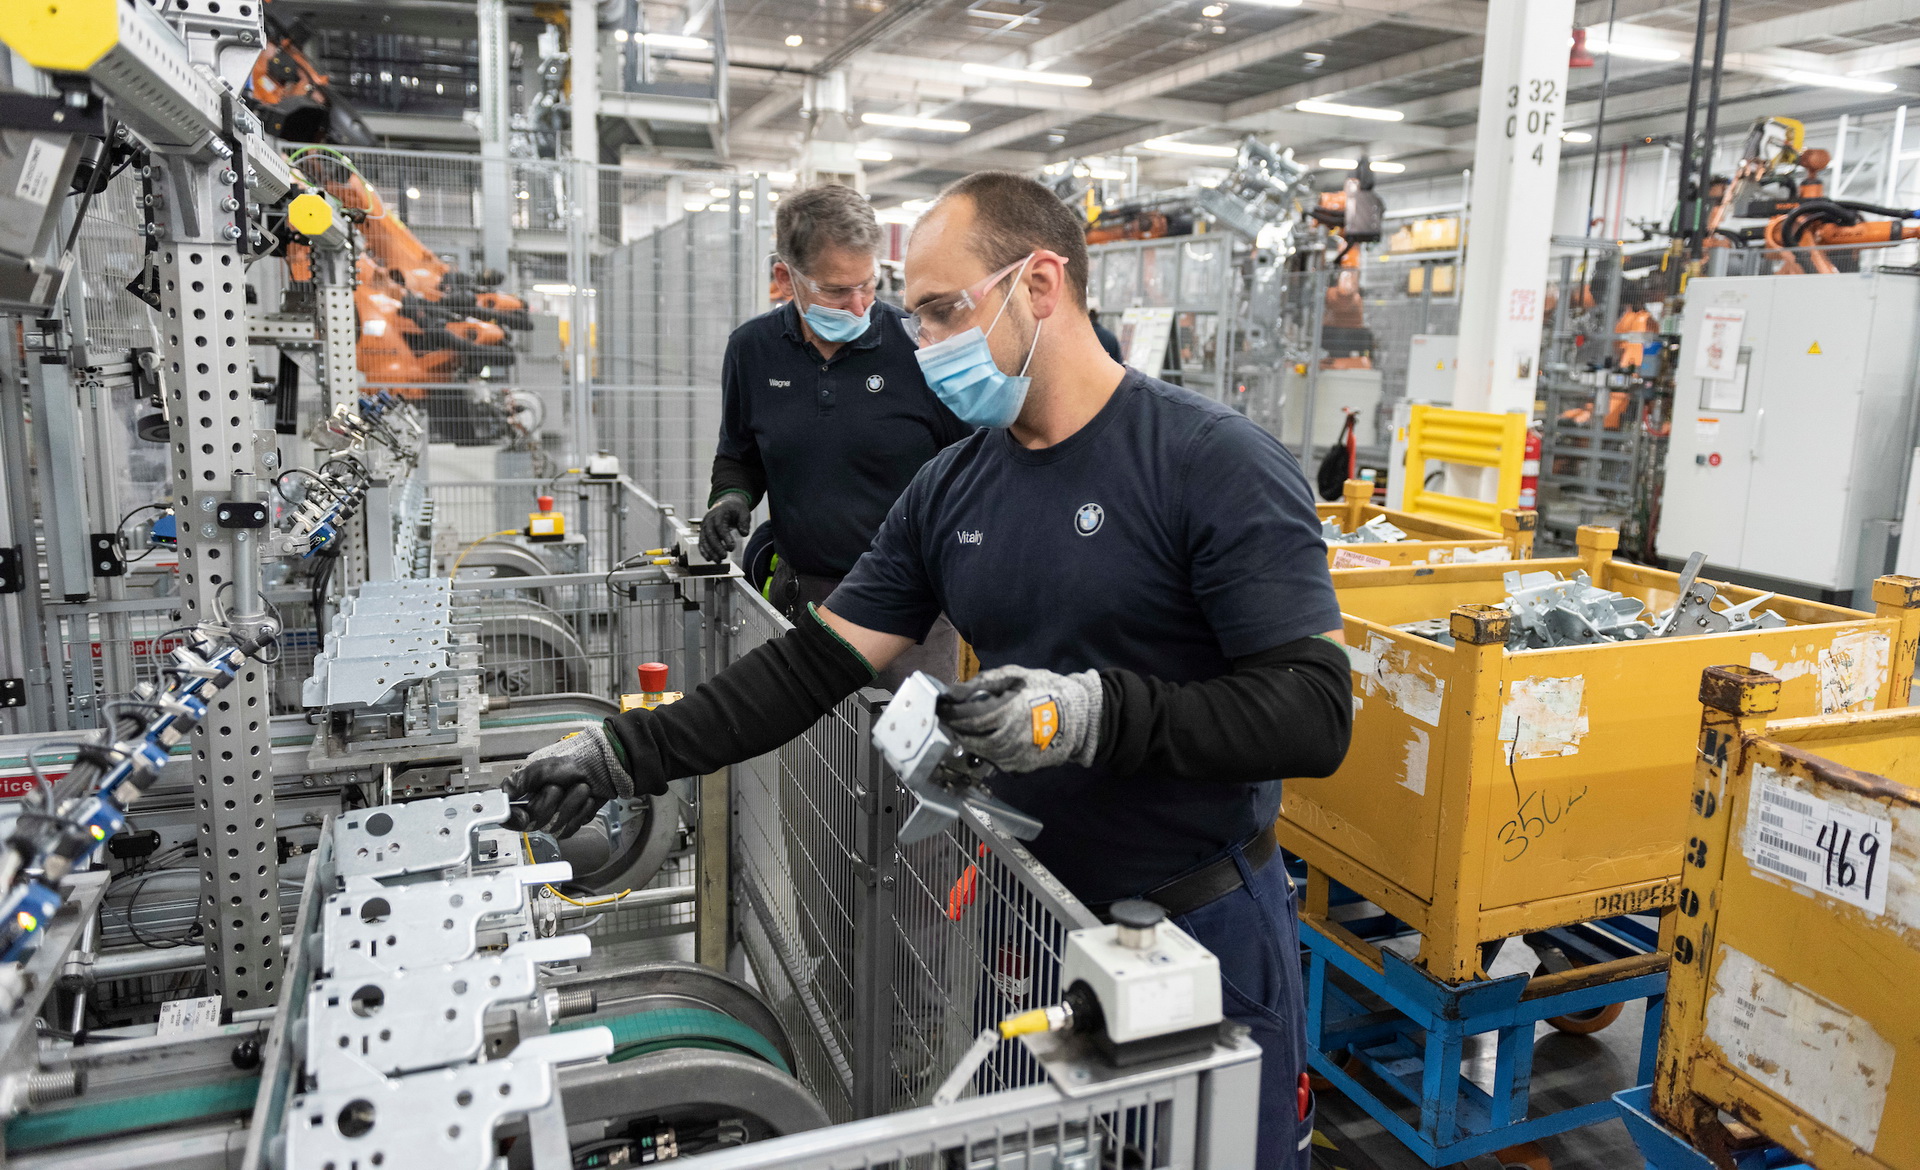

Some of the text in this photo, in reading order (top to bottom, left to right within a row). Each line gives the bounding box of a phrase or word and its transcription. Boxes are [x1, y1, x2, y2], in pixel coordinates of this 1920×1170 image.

[1532, 143, 1543, 166] 4
[769, 379, 791, 388] Wagner
[0, 780, 33, 793] ice
[1815, 820, 1880, 900] 469
[1594, 882, 1681, 915] PROPER
